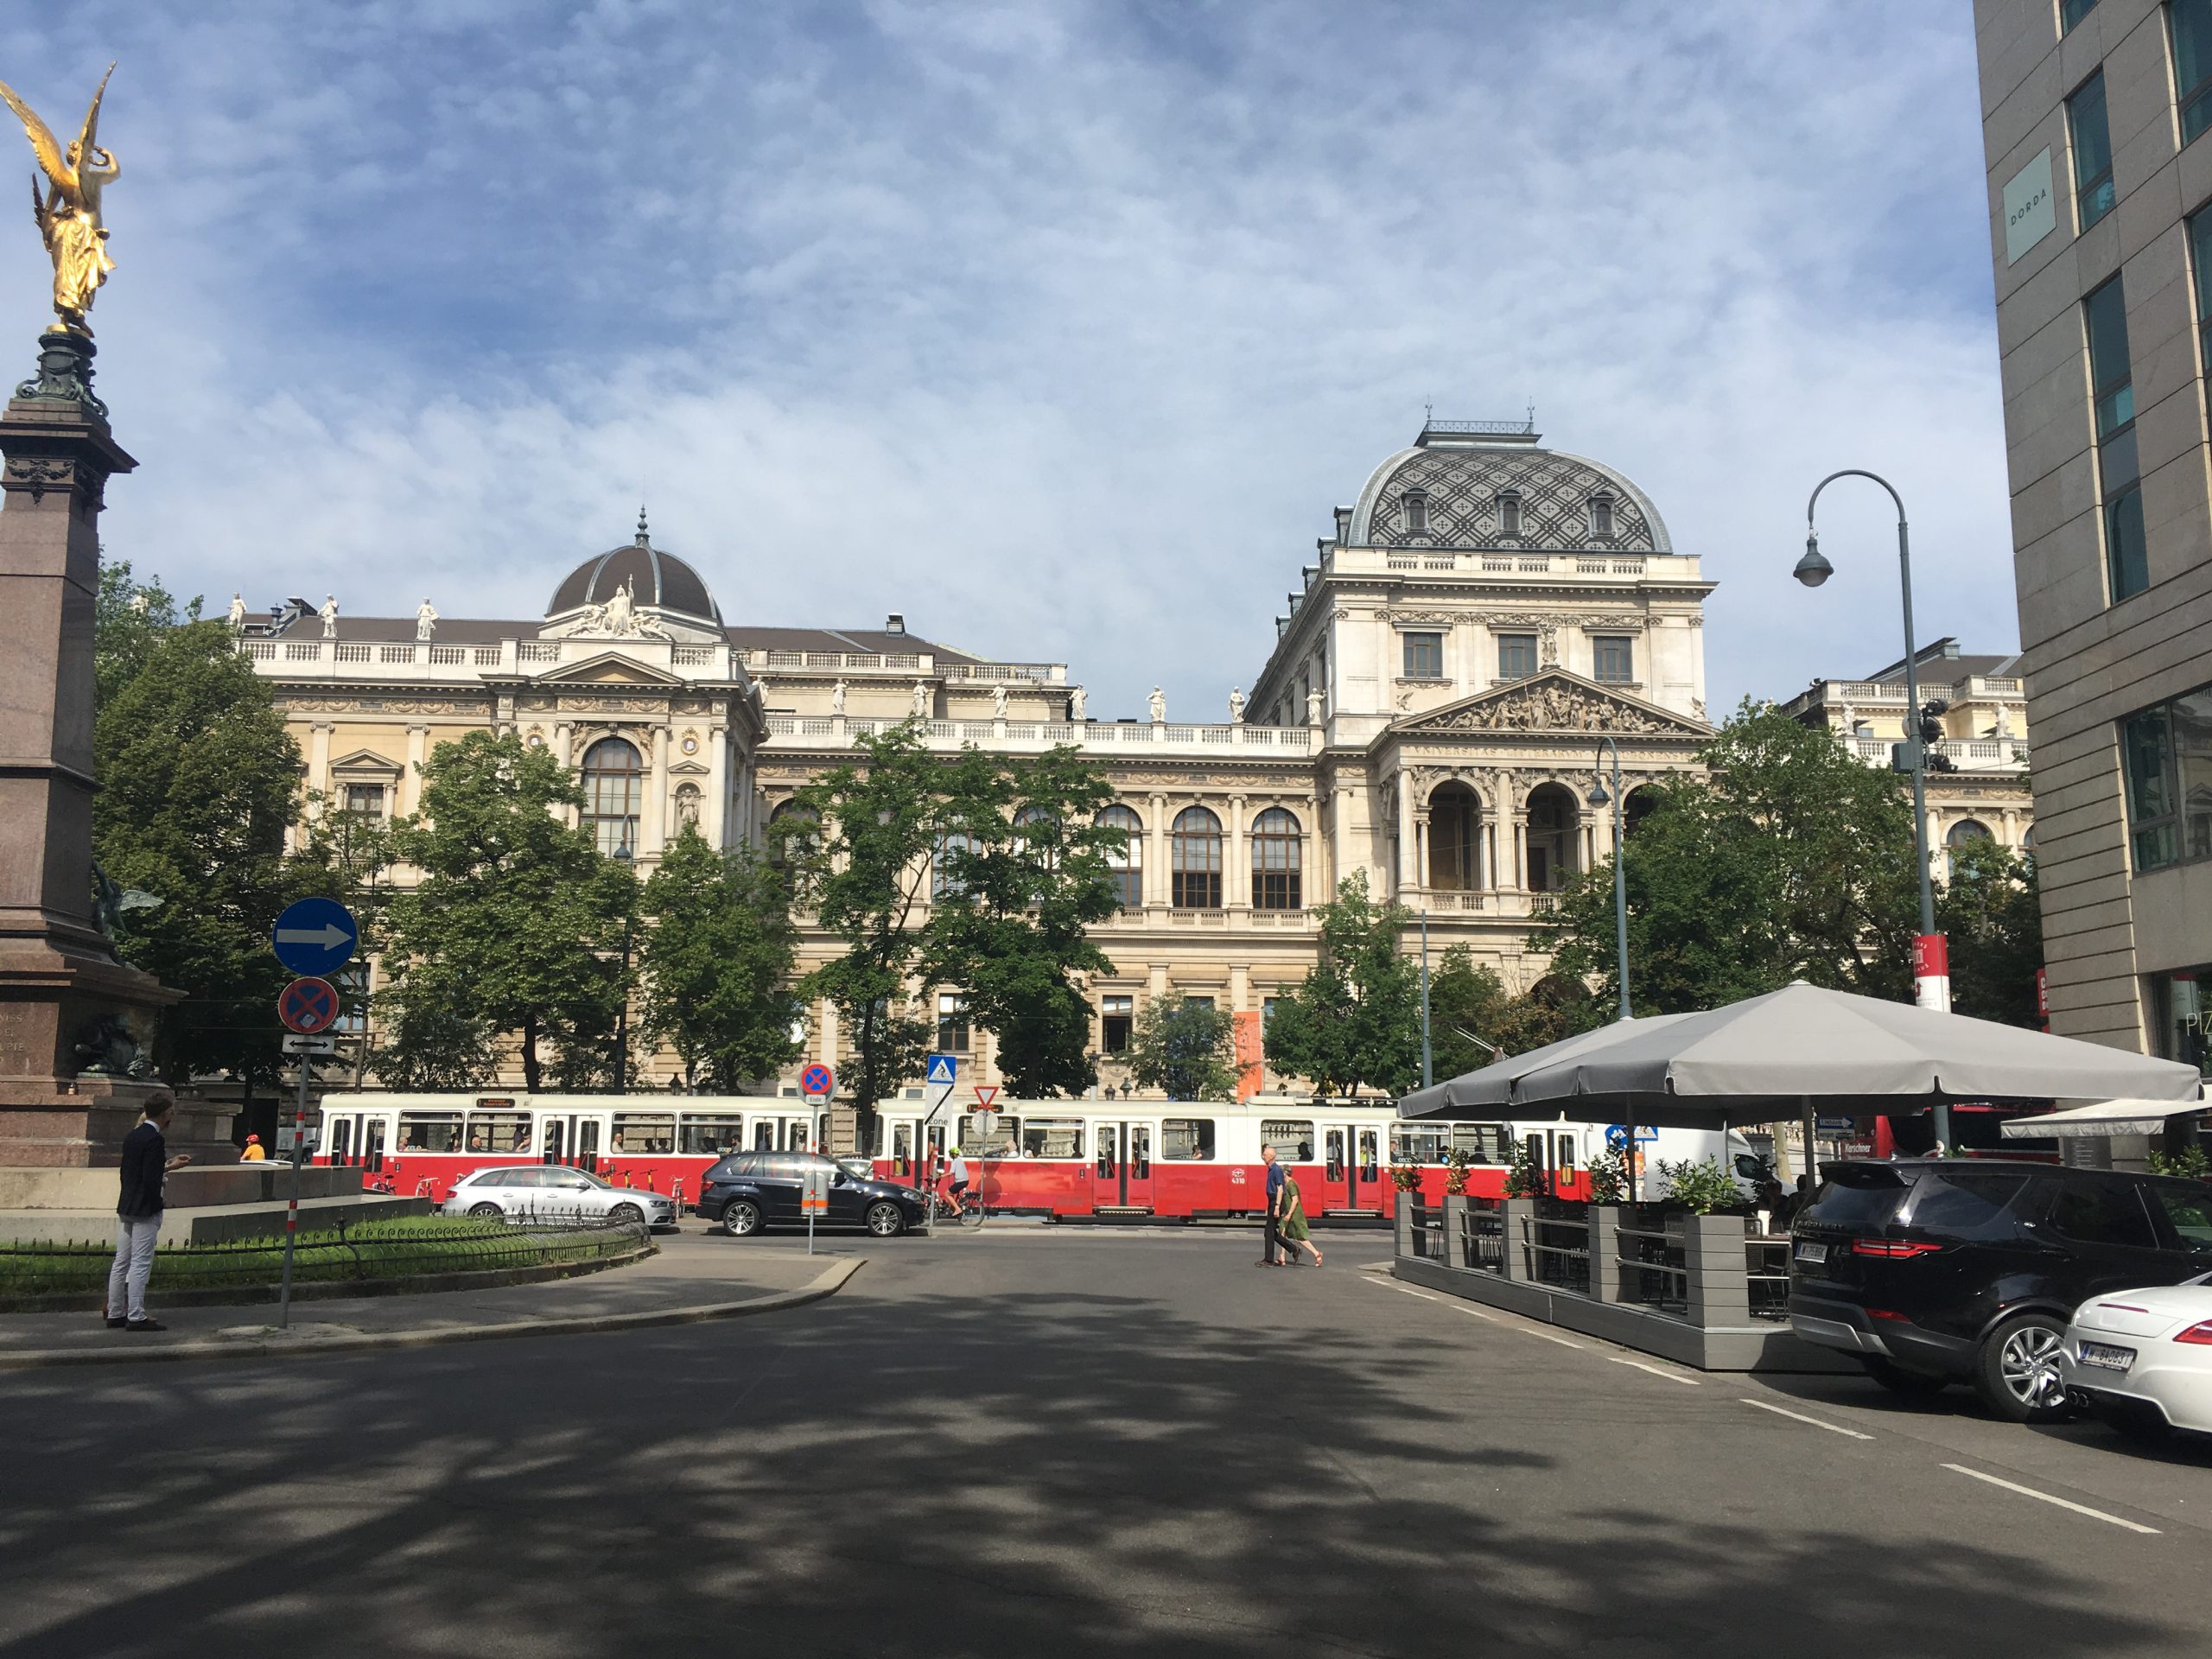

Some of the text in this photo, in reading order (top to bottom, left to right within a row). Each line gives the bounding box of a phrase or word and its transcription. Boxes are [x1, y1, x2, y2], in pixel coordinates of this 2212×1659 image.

[2011, 188, 2047, 226] DORDA
[928, 1116, 949, 1126] Zone
[2088, 1346, 2095, 1359] W
